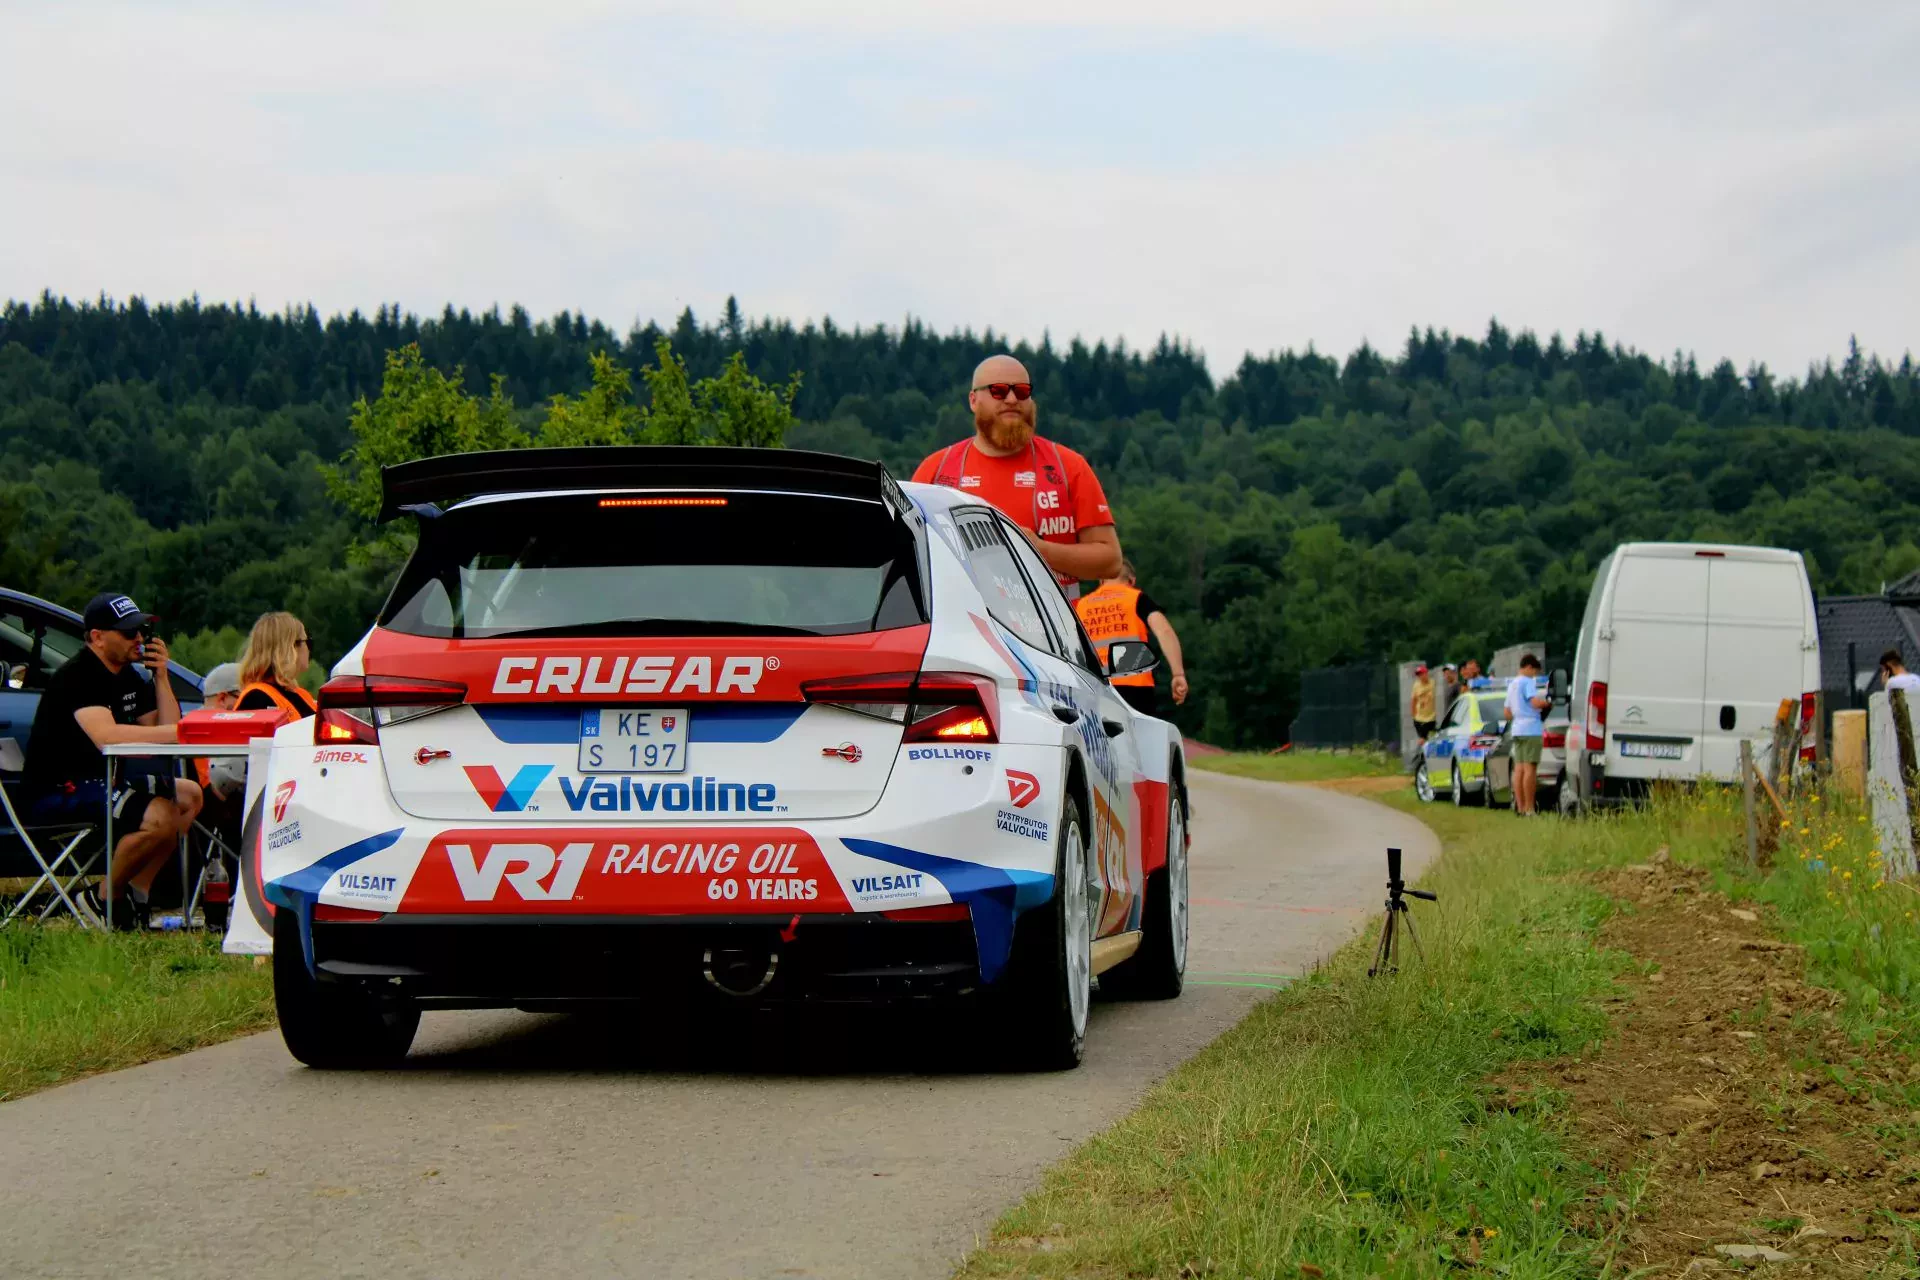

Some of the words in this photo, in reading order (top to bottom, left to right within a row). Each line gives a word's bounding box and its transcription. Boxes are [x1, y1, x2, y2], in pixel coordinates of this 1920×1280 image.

[1037, 490, 1060, 509] GE
[1083, 613, 1126, 626] SAFETY
[1086, 603, 1122, 616] STAGE
[1089, 623, 1129, 636] FFICER
[585, 726, 597, 735] SK
[618, 713, 652, 736] KE
[313, 750, 368, 764] Bimex
[589, 744, 604, 767] S
[629, 743, 677, 767] 197
[908, 748, 992, 761] BÖLLHOFF
[558, 776, 776, 811] Valvoline
[996, 818, 1048, 841] VALVOLINE
[998, 809, 1048, 831] DYSTRYBUTOR
[268, 830, 302, 851] VALVOLINE
[601, 843, 740, 874] RACING
[748, 843, 799, 874] OIL
[445, 842, 595, 901] VR1
[339, 874, 397, 892] VILSAIT
[707, 878, 739, 900] 60
[746, 878, 818, 900] YEARS
[851, 873, 923, 893] VILSAIT
